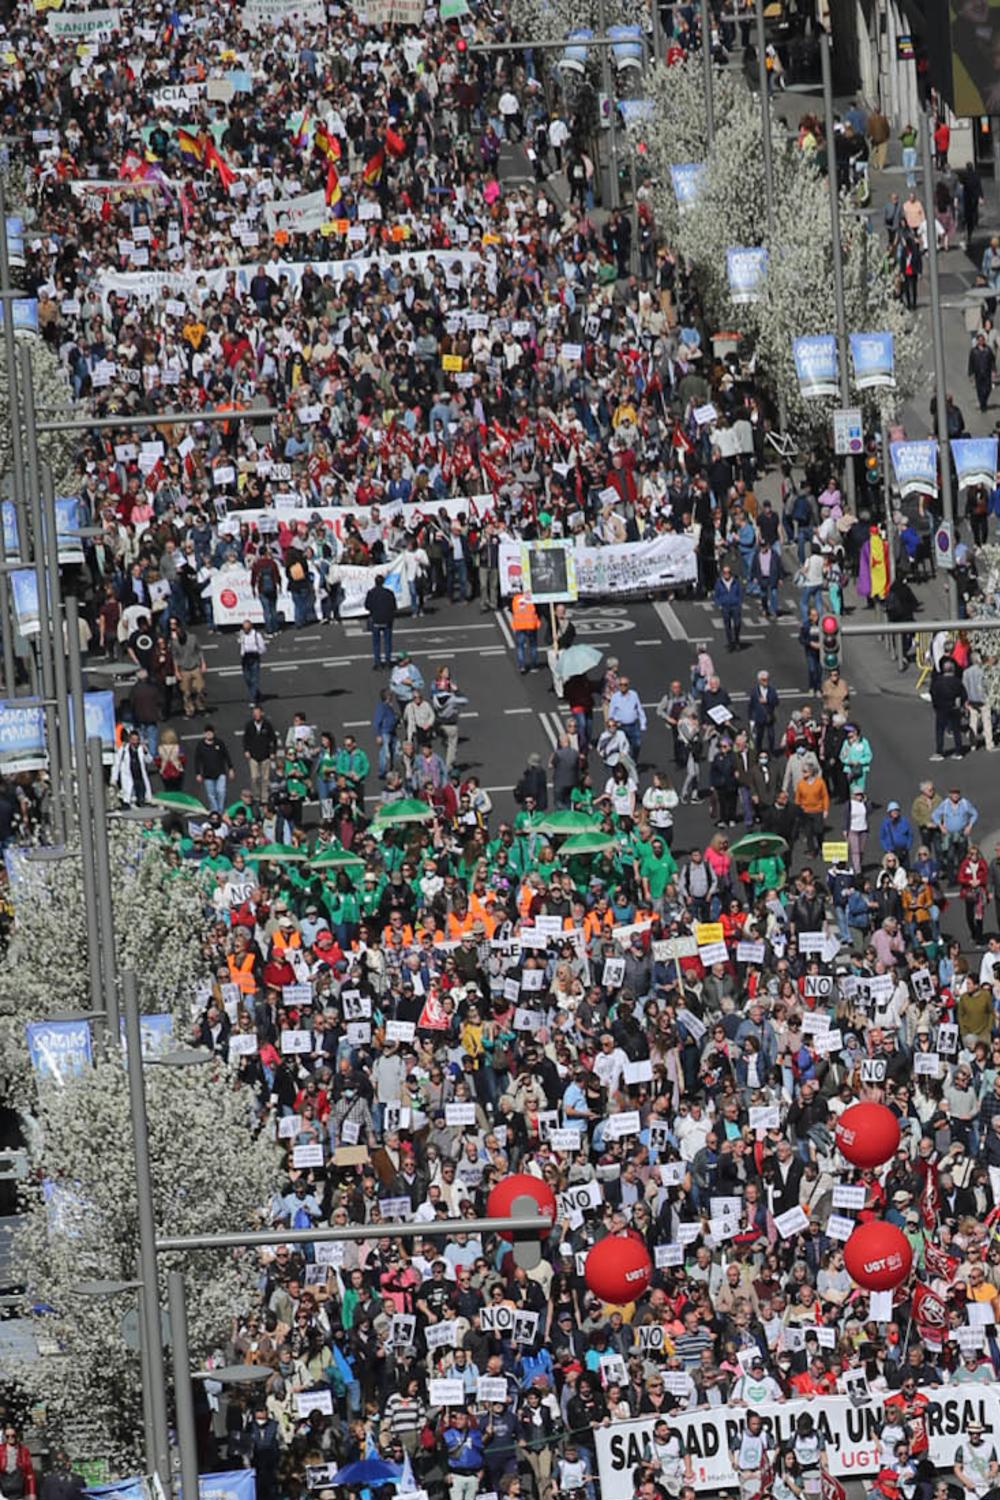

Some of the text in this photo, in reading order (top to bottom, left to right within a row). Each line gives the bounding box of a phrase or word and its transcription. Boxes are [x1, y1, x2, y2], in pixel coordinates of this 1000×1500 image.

[54, 20, 114, 33] SANIDAD
[806, 977, 830, 993] NO
[862, 1062, 883, 1079] NO
[563, 1189, 591, 1211] NO
[864, 1255, 886, 1272] UGT
[482, 1308, 507, 1326] NO
[639, 1326, 662, 1345] NO
